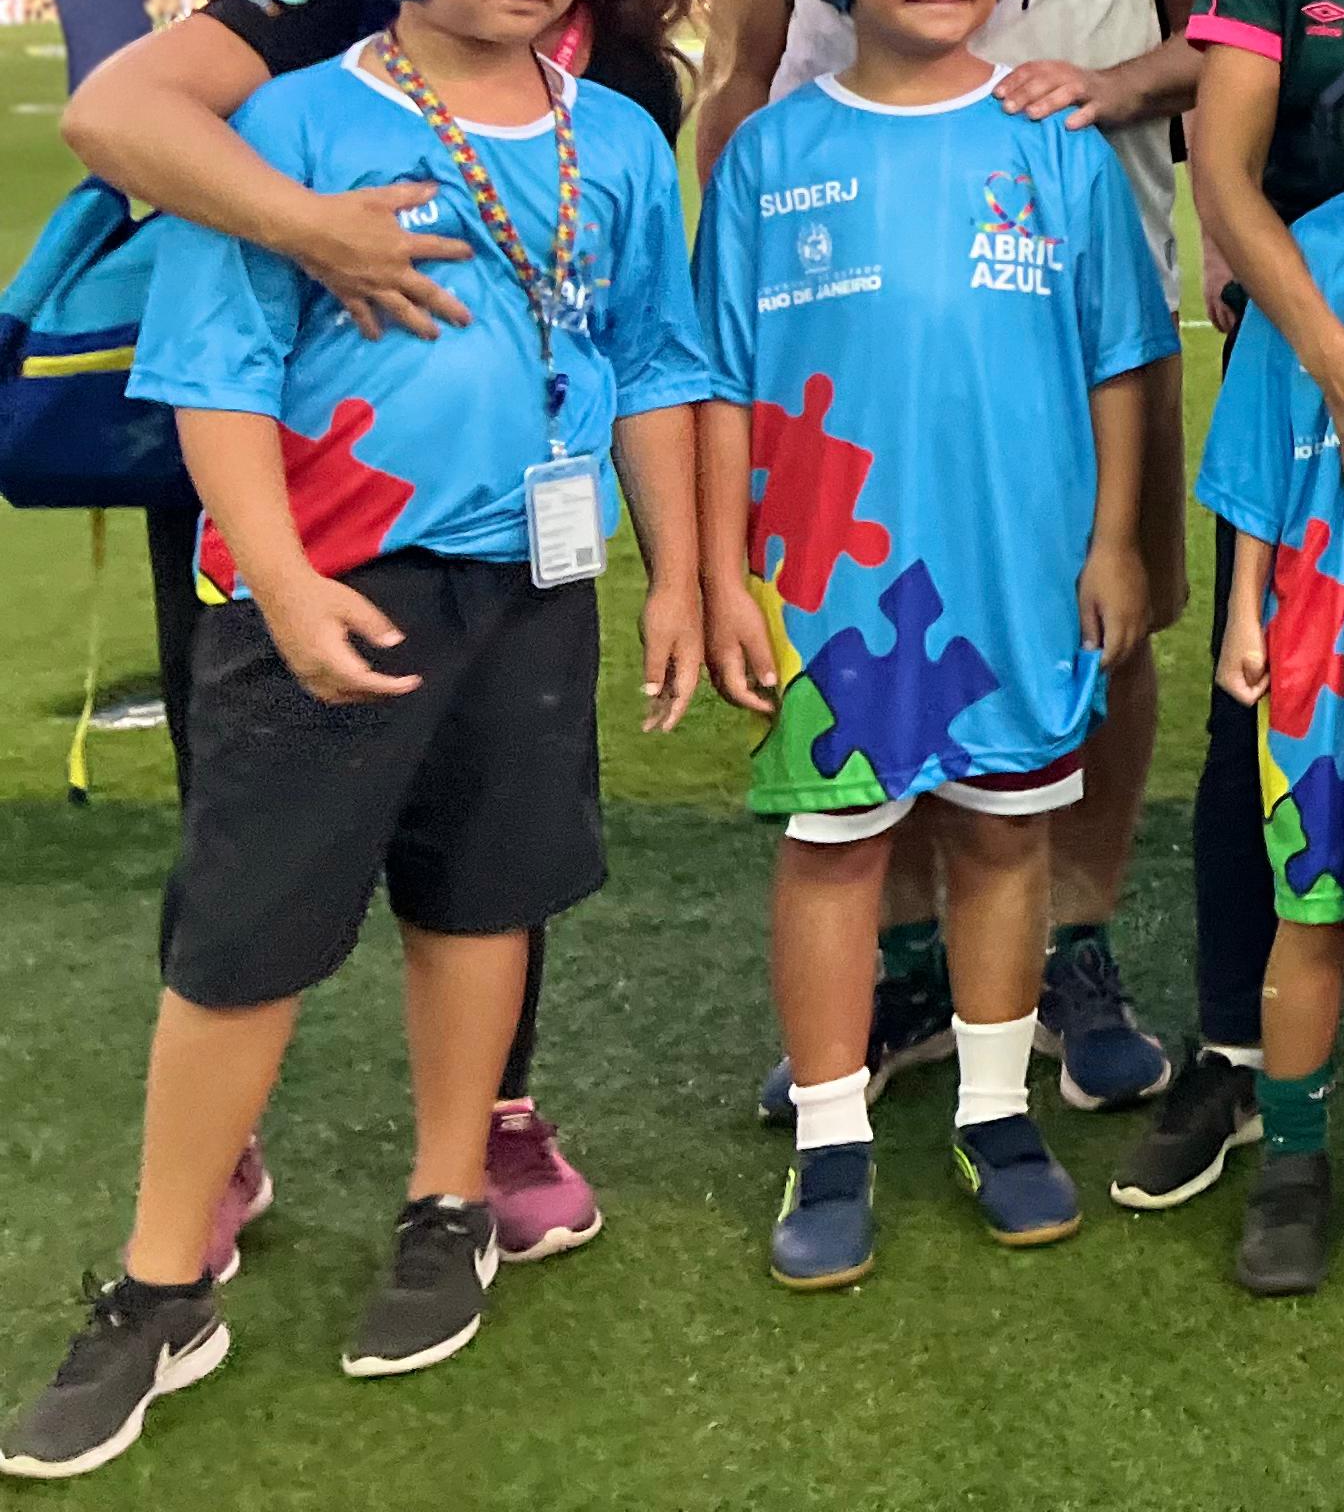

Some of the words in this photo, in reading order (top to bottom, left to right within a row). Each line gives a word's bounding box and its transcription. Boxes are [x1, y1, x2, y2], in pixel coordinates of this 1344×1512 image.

[760, 178, 859, 218] SUDERJ
[969, 232, 1064, 272] ABRIL
[970, 261, 1052, 296] AZUL
